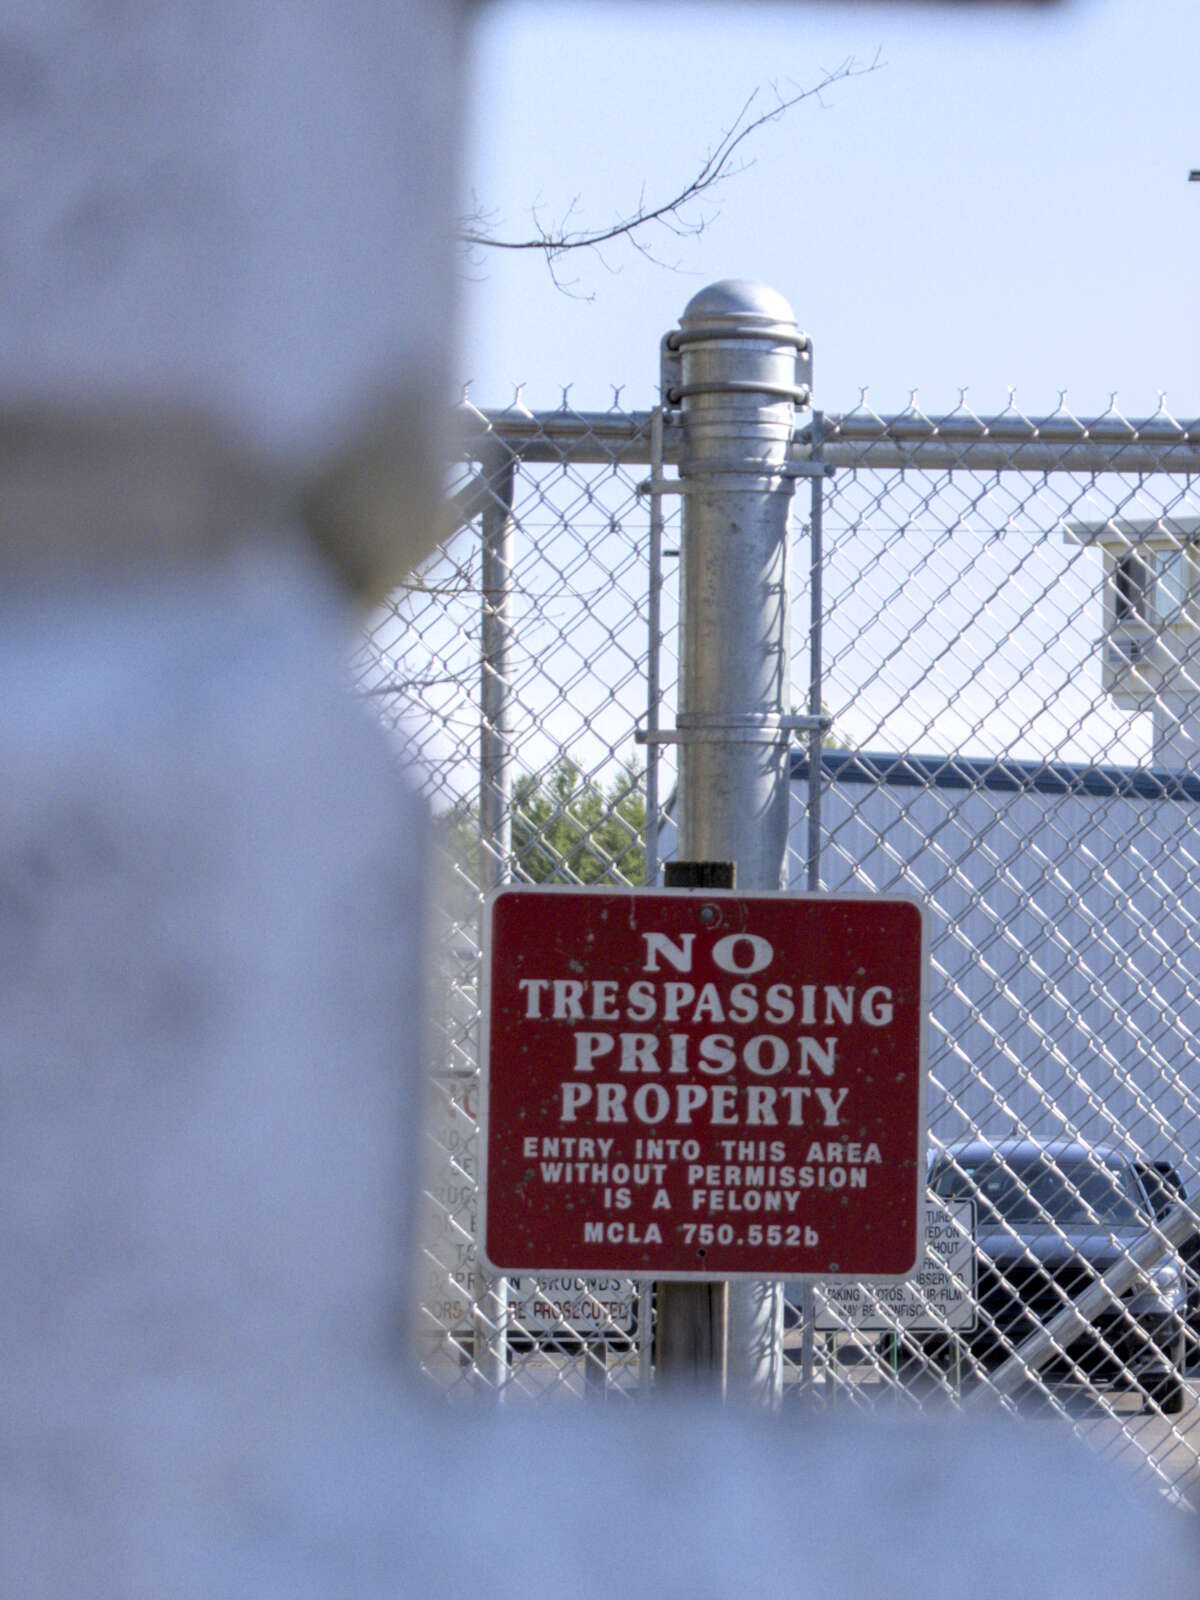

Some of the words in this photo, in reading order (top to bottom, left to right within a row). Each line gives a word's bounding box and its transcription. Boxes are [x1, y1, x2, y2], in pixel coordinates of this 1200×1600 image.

[641, 932, 774, 975] NO
[518, 978, 895, 1027] TRESPASSING
[573, 1031, 839, 1076] PRISON
[560, 1082, 850, 1127] PROPERTY
[523, 1136, 614, 1160] ENTRY
[635, 1139, 701, 1161] INTO
[721, 1140, 786, 1163] THIS
[806, 1141, 883, 1164] AREA
[540, 1161, 668, 1185] WITHOUT
[687, 1164, 868, 1188] PERMISSION
[604, 1187, 632, 1210] IS
[652, 1188, 672, 1210] A
[692, 1189, 801, 1212] FELONY
[583, 1221, 663, 1244] MCLA
[682, 1223, 820, 1247] 750.552b
